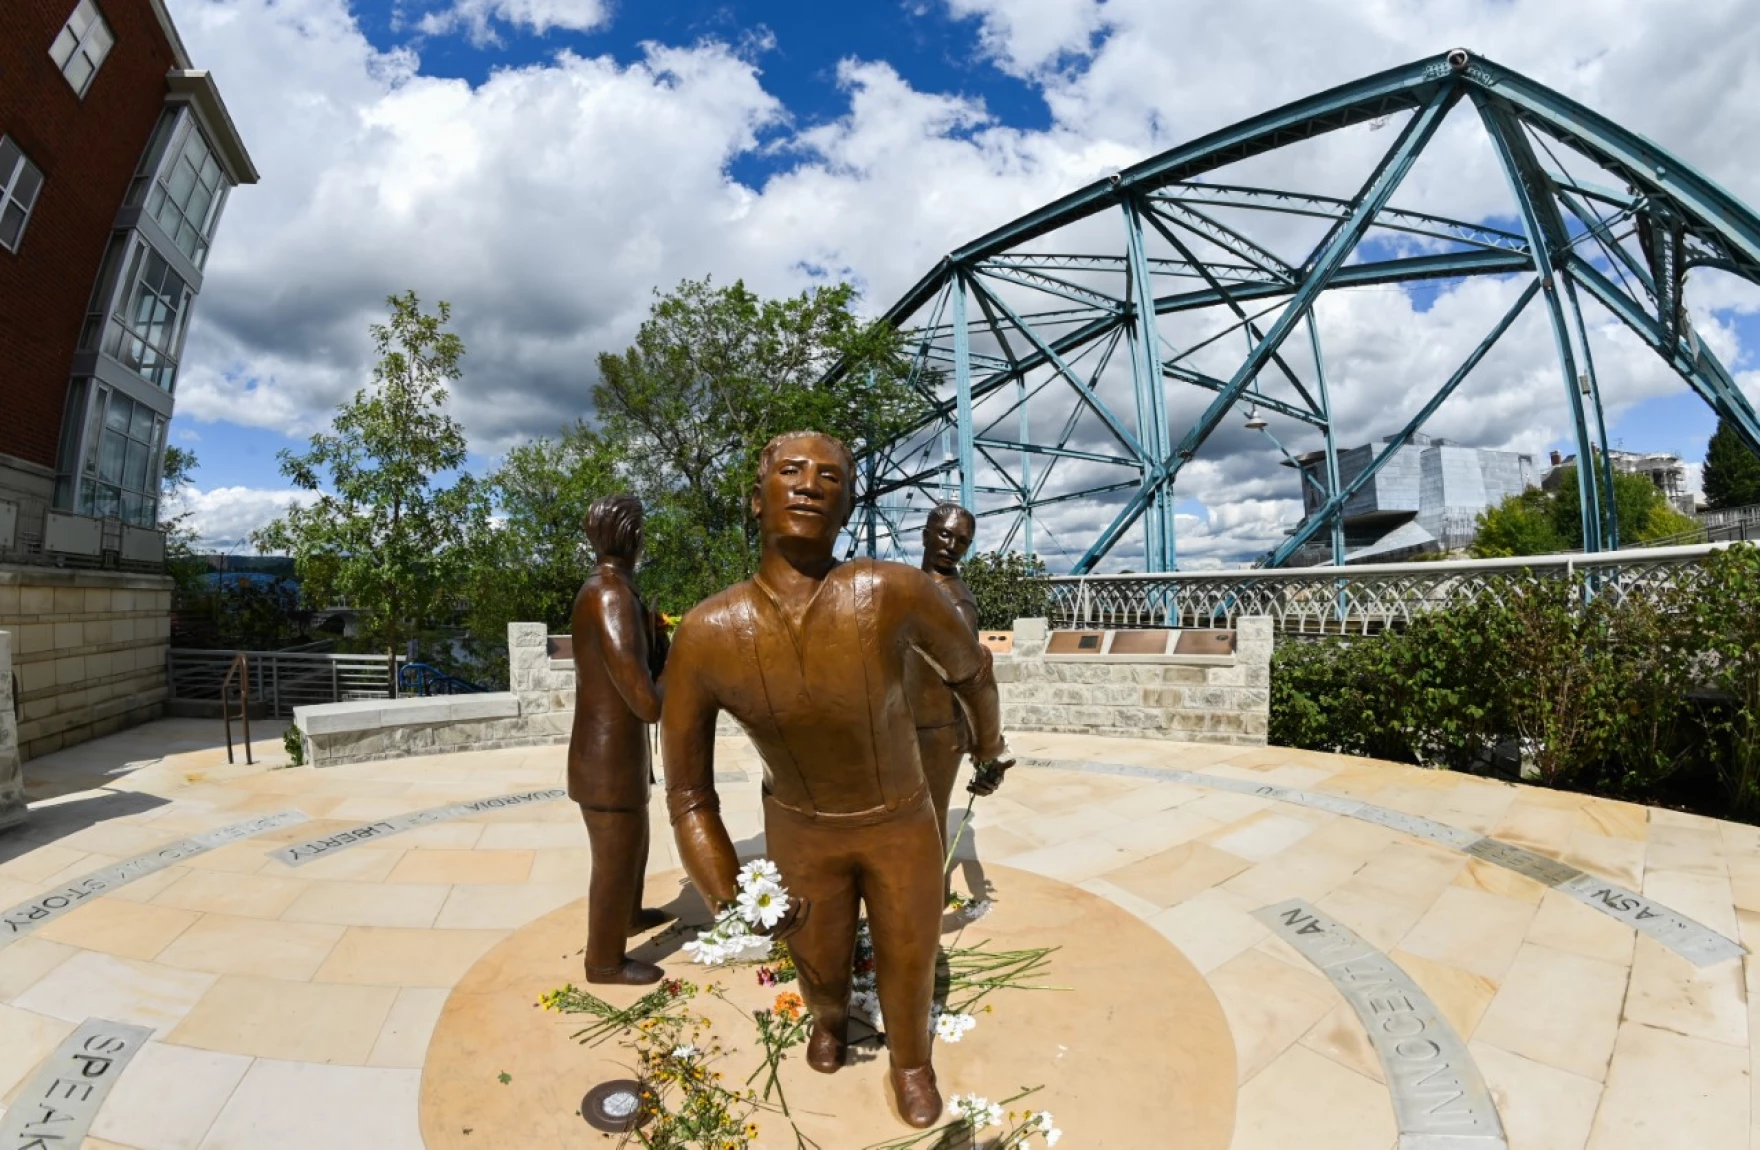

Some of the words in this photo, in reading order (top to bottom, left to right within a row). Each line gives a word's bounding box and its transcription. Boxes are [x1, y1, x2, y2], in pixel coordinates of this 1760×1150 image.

[451, 789, 567, 814] GUARDIA
[288, 820, 396, 862] LIBERTY
[3, 876, 107, 935] STORY
